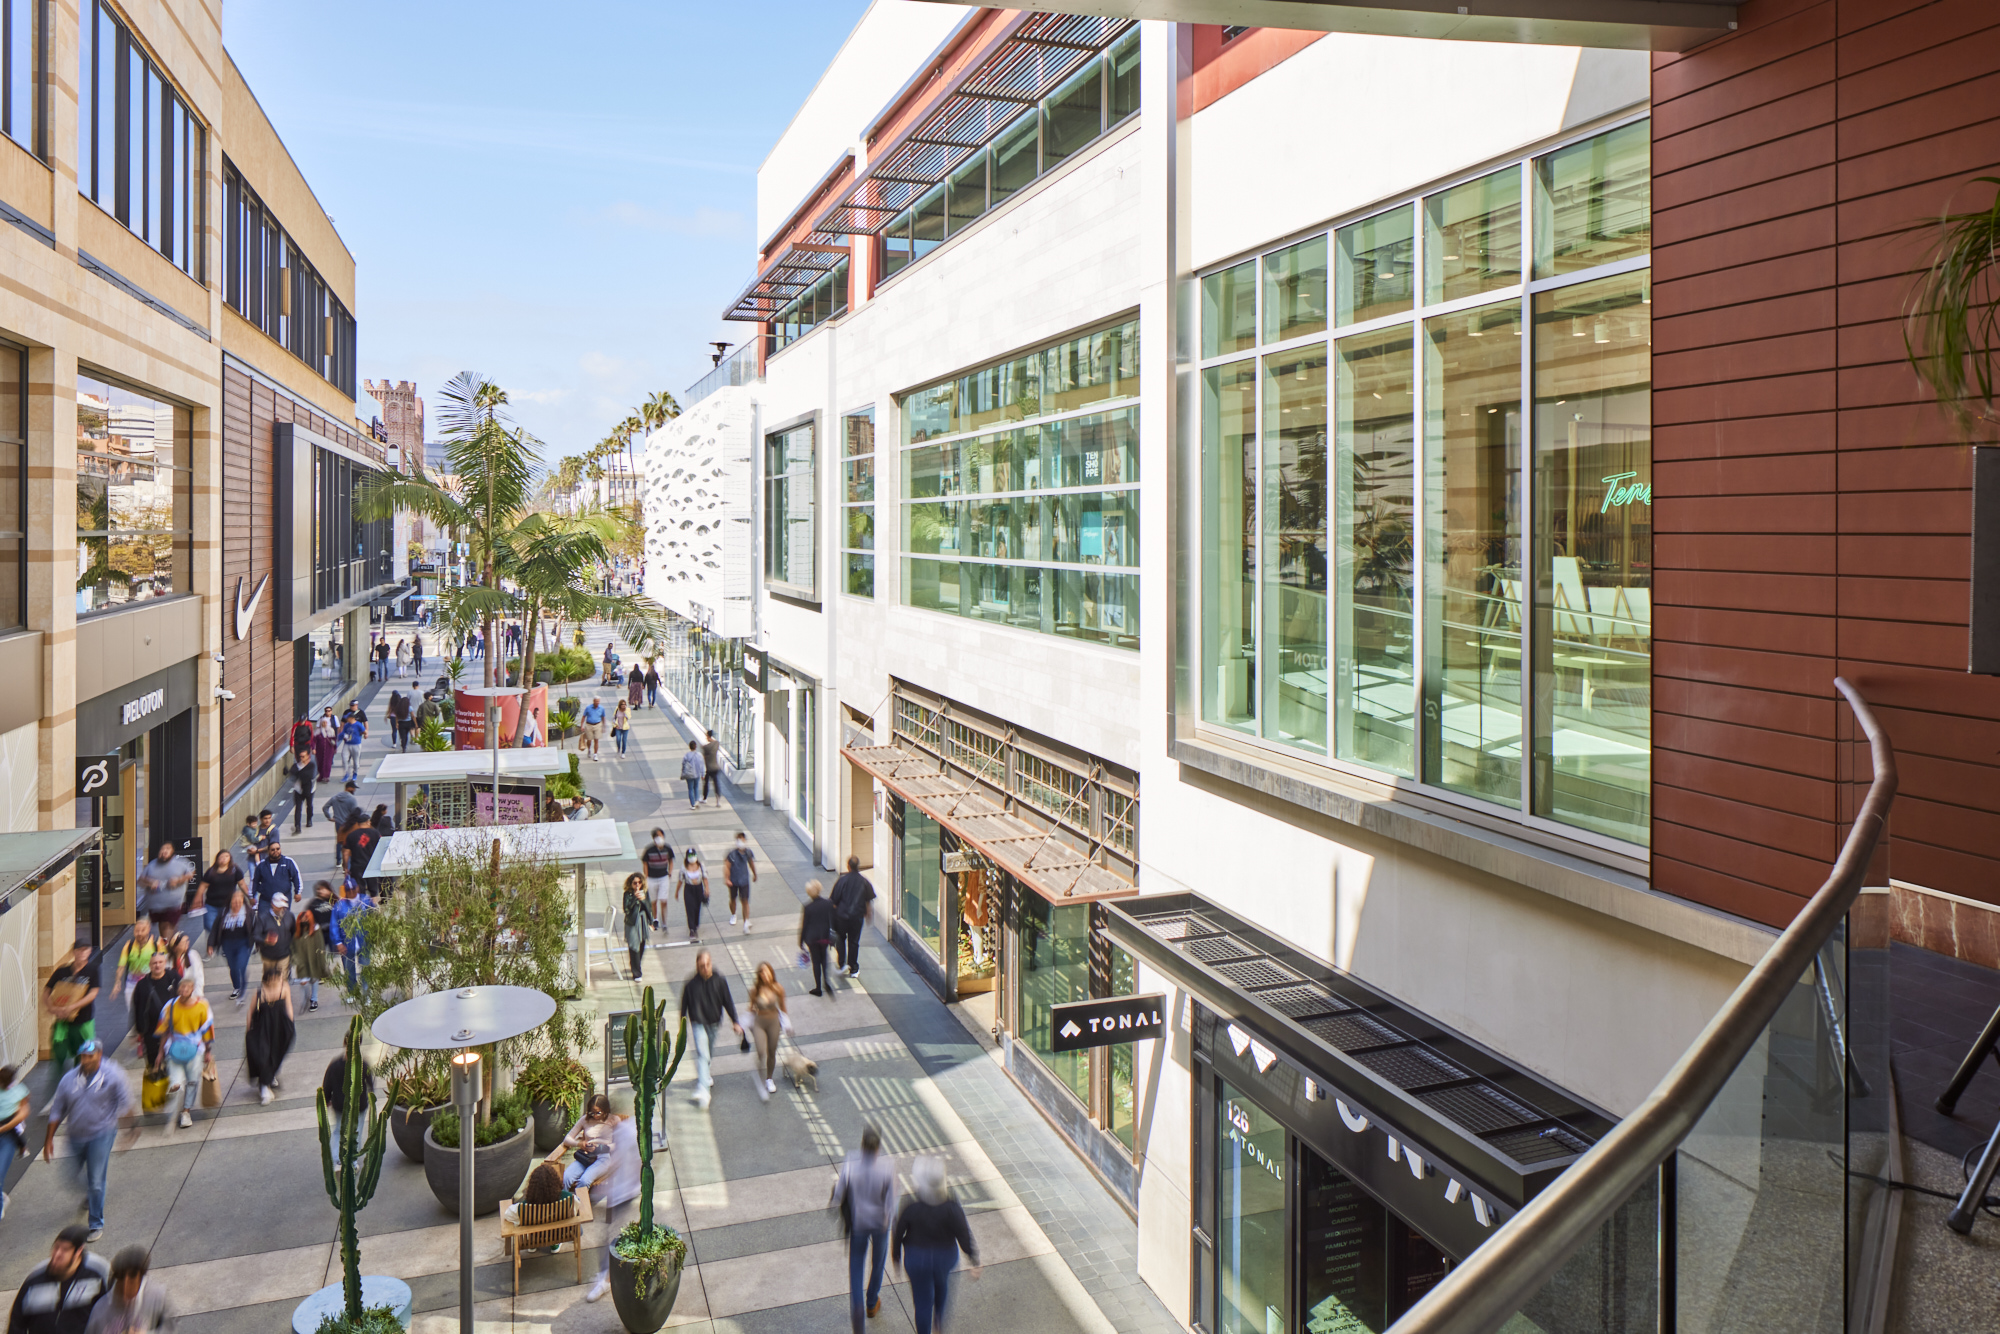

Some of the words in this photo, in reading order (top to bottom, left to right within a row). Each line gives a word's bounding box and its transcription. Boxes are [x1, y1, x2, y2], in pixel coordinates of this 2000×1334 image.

[1086, 451, 1098, 460] TEN
[1086, 460, 1098, 469] SHO
[1086, 468, 1098, 477] PPE
[123, 688, 163, 725] PELOTON
[1089, 1011, 1162, 1033] TONAL
[1228, 1100, 1249, 1133] 126
[1240, 1136, 1282, 1180] TONAL
[1329, 1203, 1359, 1213] MOBILITY
[1332, 1216, 1356, 1225] CARDIO
[1325, 1227, 1362, 1238] MEDITATION
[1325, 1242, 1347, 1250] FAMILY
[1327, 1251, 1360, 1262] RECOVERY
[1325, 1262, 1361, 1274] BOOTCAMP
[1332, 1276, 1354, 1284] DANCE
[1330, 1288, 1356, 1296] PILATES
